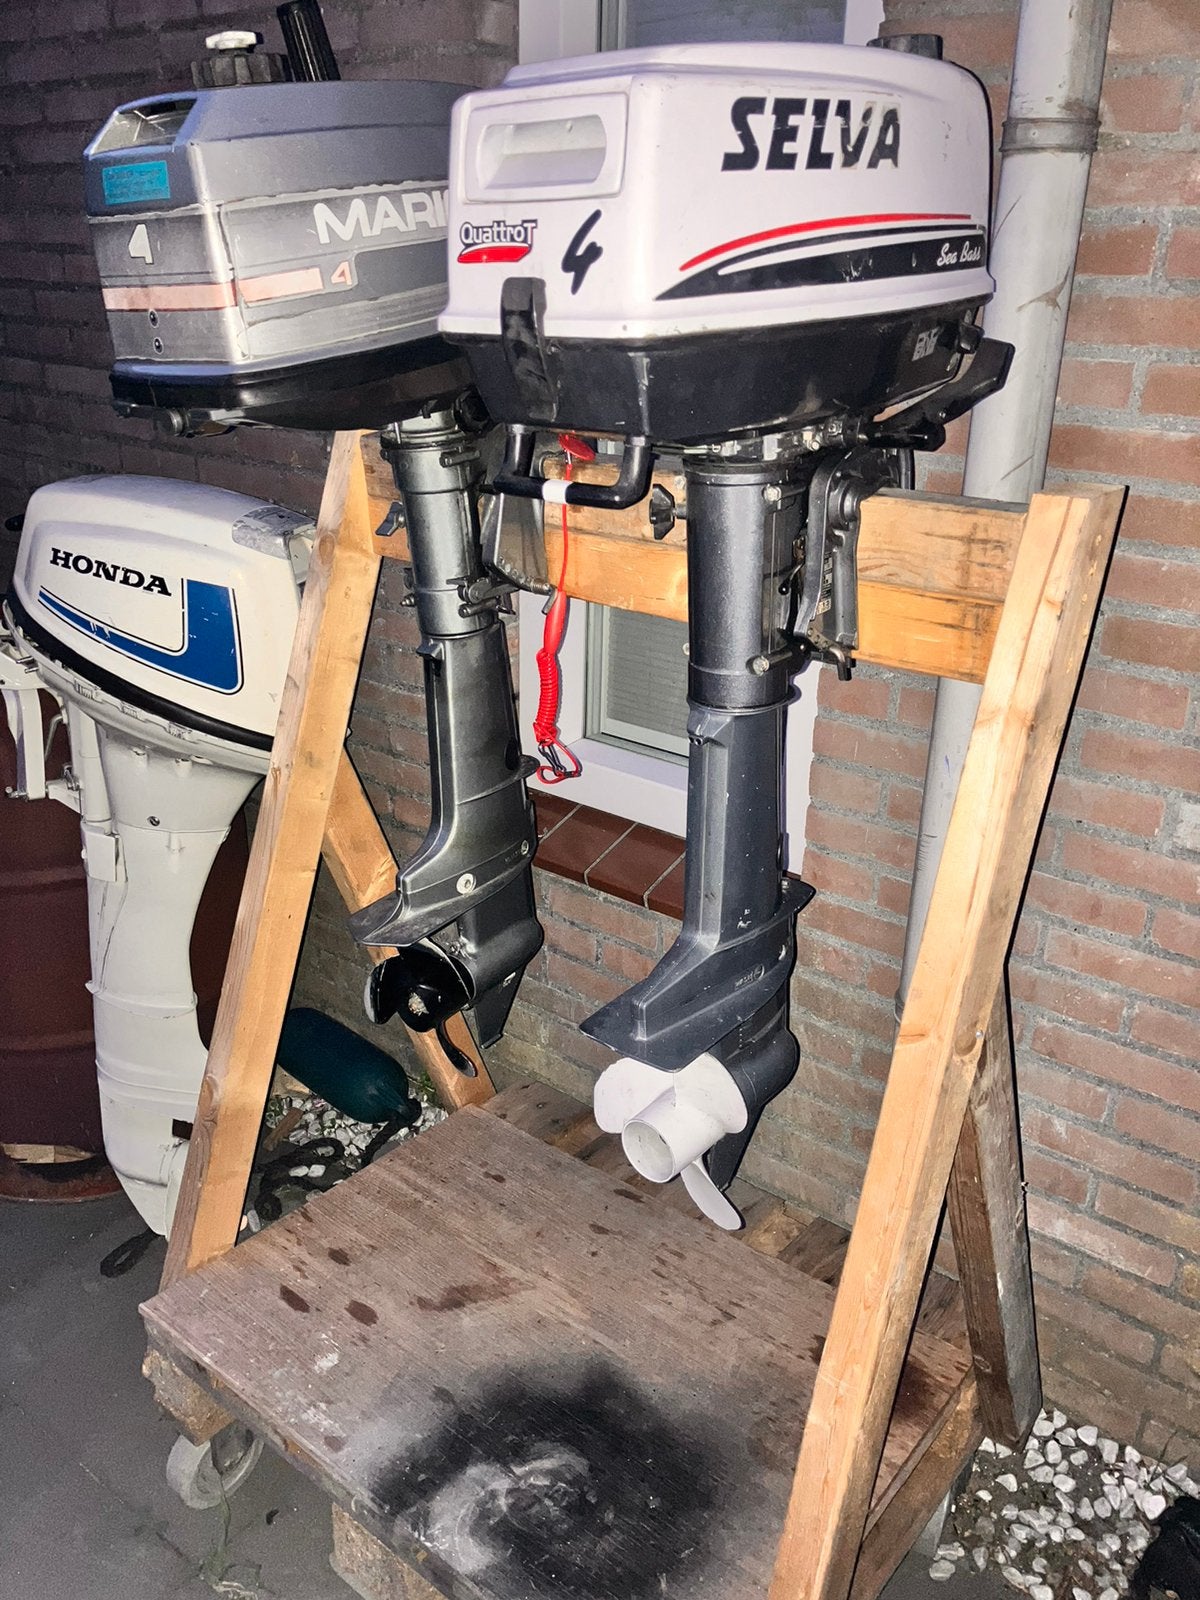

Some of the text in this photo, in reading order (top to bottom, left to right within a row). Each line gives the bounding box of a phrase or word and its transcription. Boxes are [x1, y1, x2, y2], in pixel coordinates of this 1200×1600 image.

[721, 96, 901, 172] SELVA
[313, 189, 448, 244] MARI
[128, 223, 155, 265] 4
[561, 208, 604, 296] 4
[936, 240, 981, 267] Sea Bass
[330, 260, 353, 286] 4
[50, 547, 172, 597] HONDA
